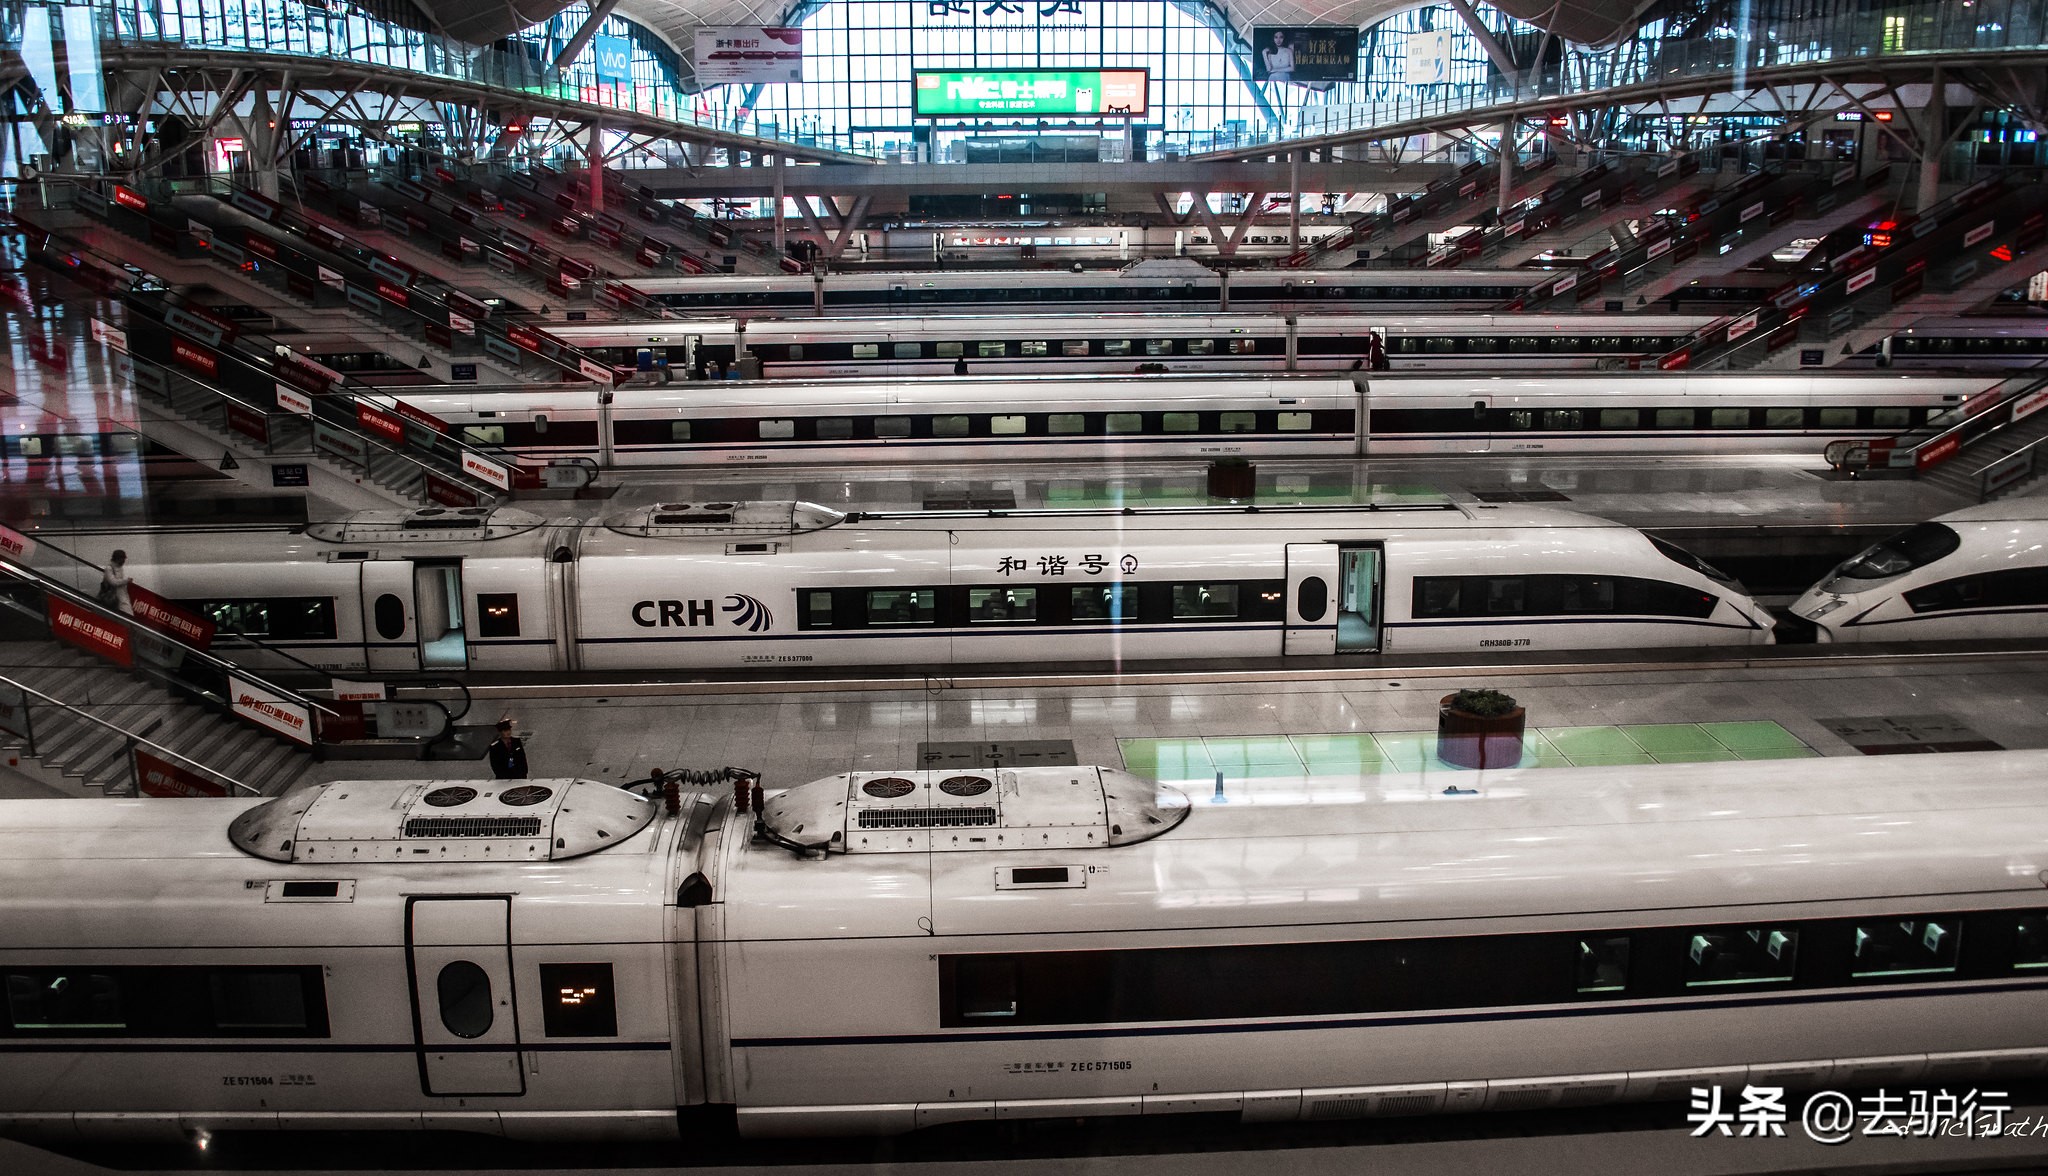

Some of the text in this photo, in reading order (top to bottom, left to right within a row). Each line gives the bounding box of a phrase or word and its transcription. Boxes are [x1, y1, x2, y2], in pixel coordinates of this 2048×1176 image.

[0, 536, 24, 554] 陶瓷
[997, 555, 1110, 577] 和谐号
[631, 599, 714, 627] CRH
[254, 700, 304, 728] 新中源陶瓷
[223, 1076, 237, 1086] ZE
